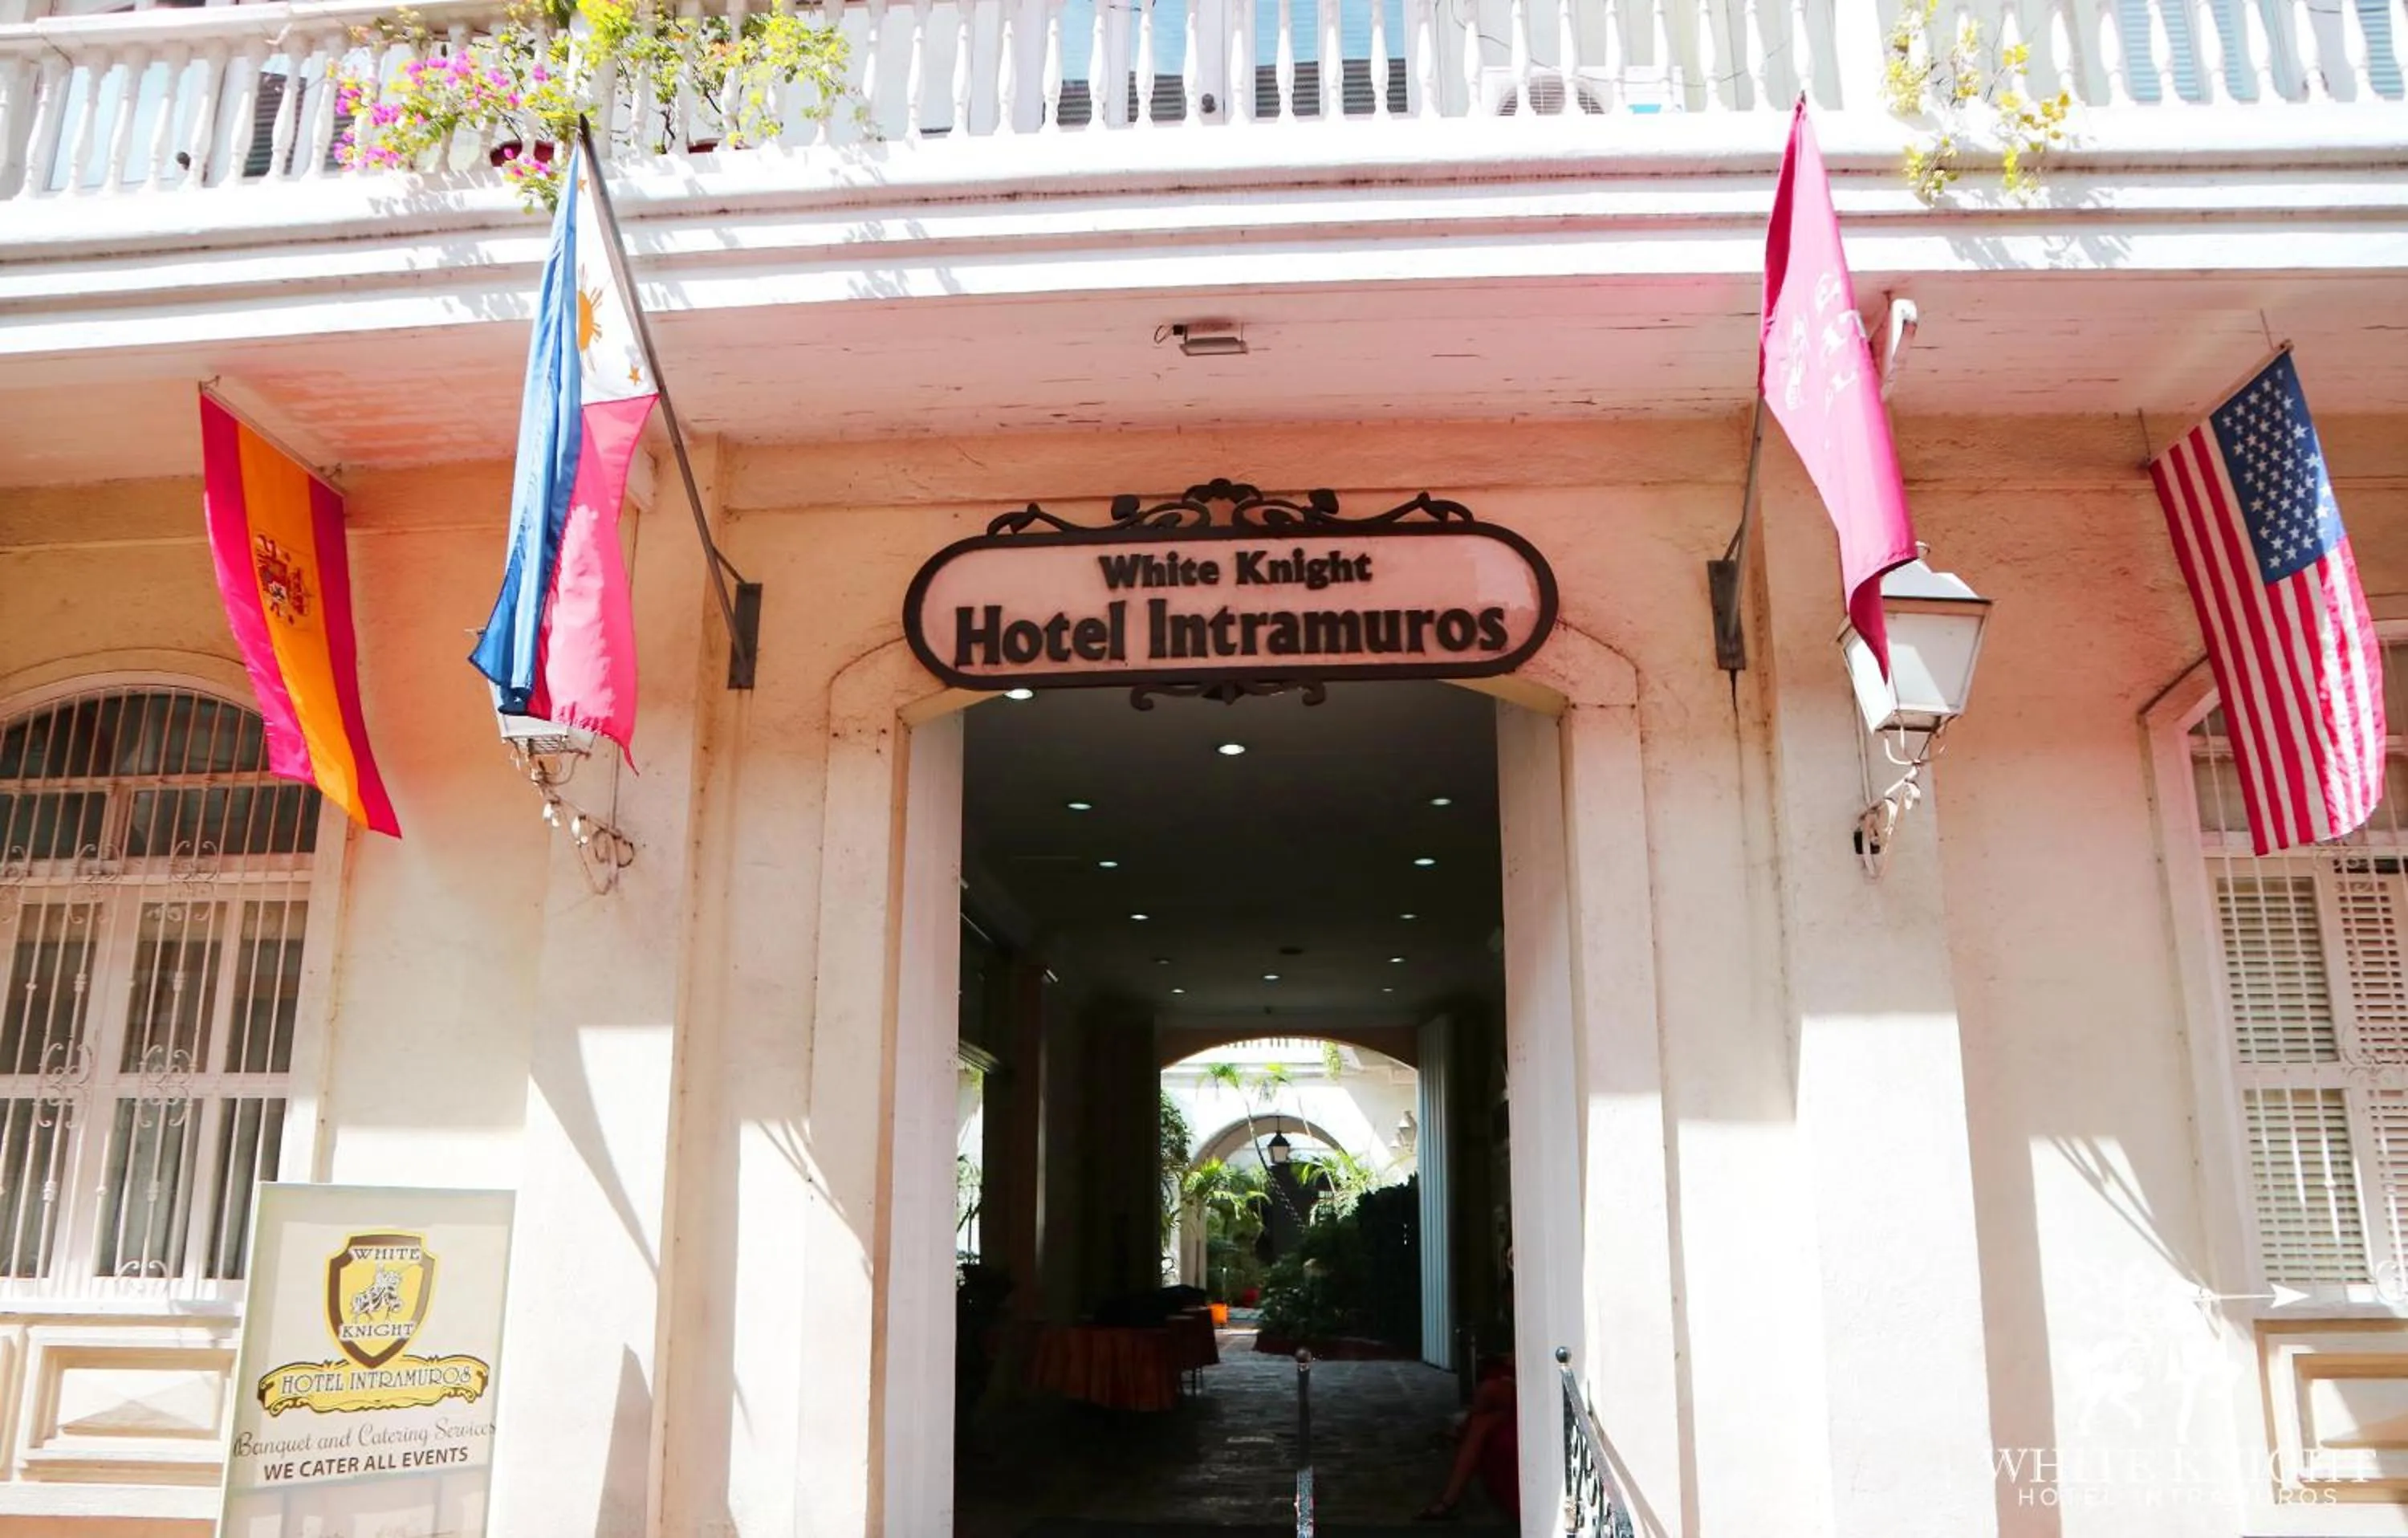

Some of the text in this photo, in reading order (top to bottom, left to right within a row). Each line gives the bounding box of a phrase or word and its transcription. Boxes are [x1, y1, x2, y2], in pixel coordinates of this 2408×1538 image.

[1099, 549, 1373, 590] White Knight
[954, 597, 1509, 667] Hotel Intramuros
[353, 1247, 421, 1260] WHITE
[342, 1324, 413, 1338] KNIGHT
[281, 1366, 472, 1394] HOTEL INTRAMUROS
[234, 1416, 496, 1459] Banquet and Catering Services
[263, 1446, 469, 1481] WE CATER ALL EVENTS
